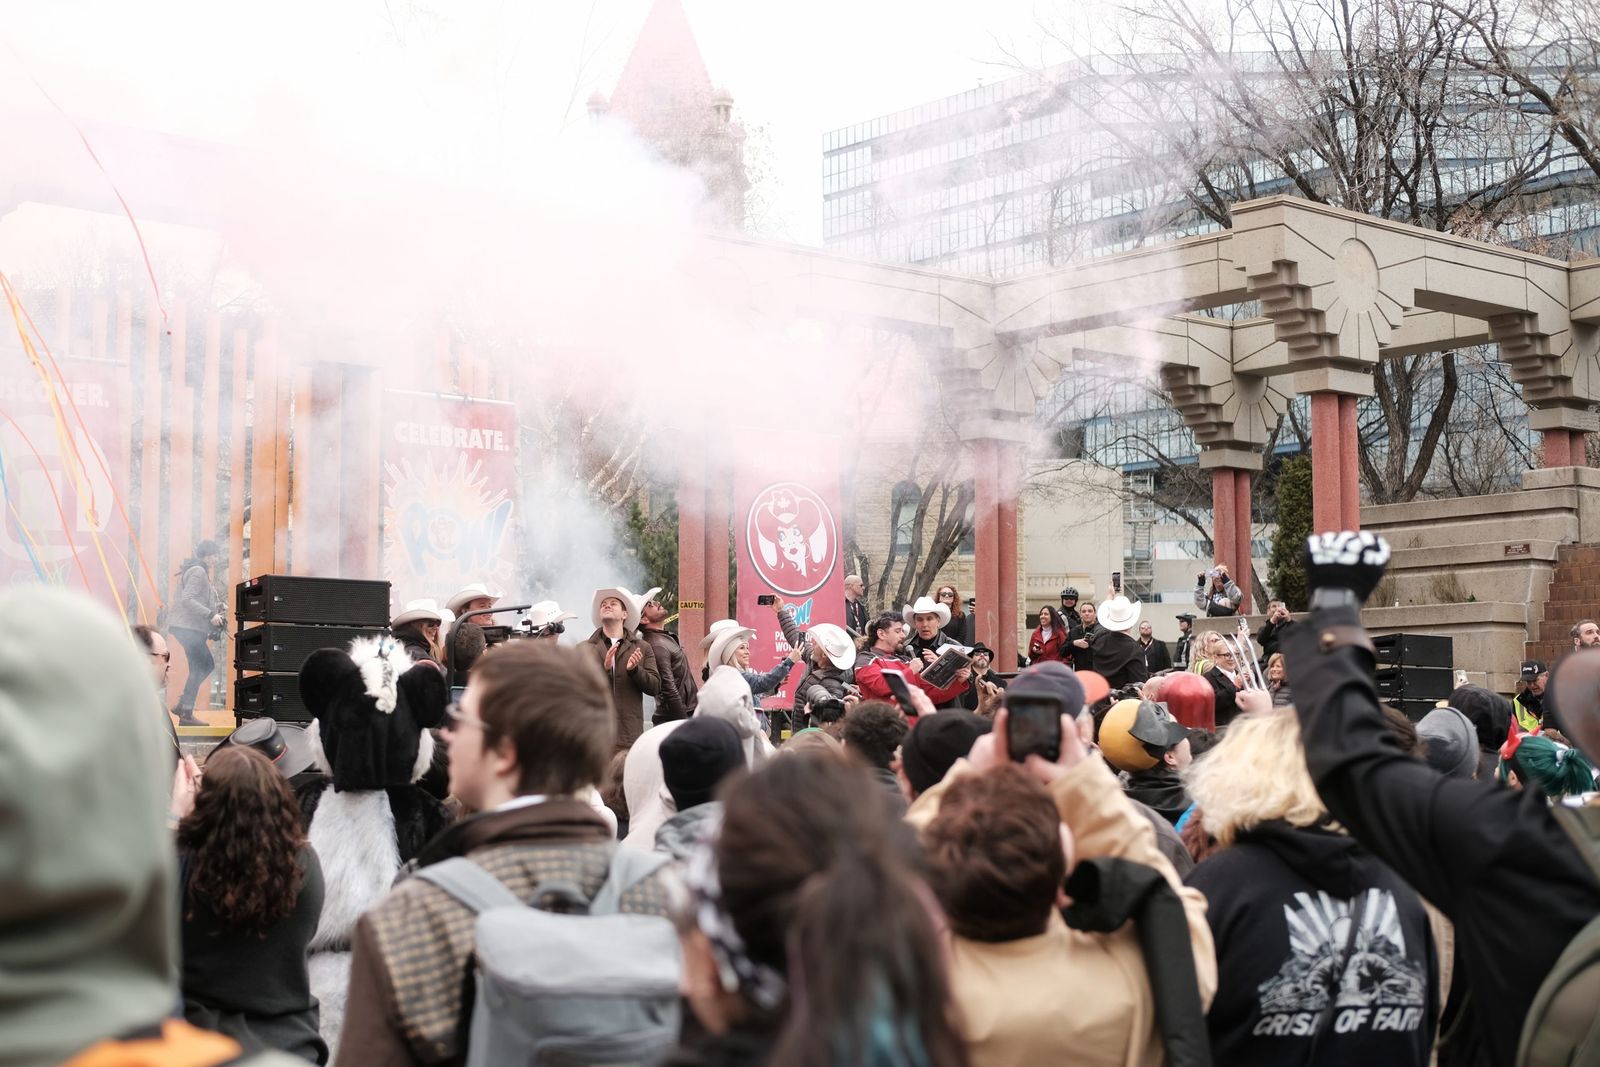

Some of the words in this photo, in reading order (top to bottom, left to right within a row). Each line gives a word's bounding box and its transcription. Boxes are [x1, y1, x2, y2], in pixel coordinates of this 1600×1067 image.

[393, 421, 509, 452] CELEBRATE.
[784, 597, 813, 627] OW!
[1252, 1012, 1322, 1036] CRISI
[1334, 1008, 1371, 1033] OF
